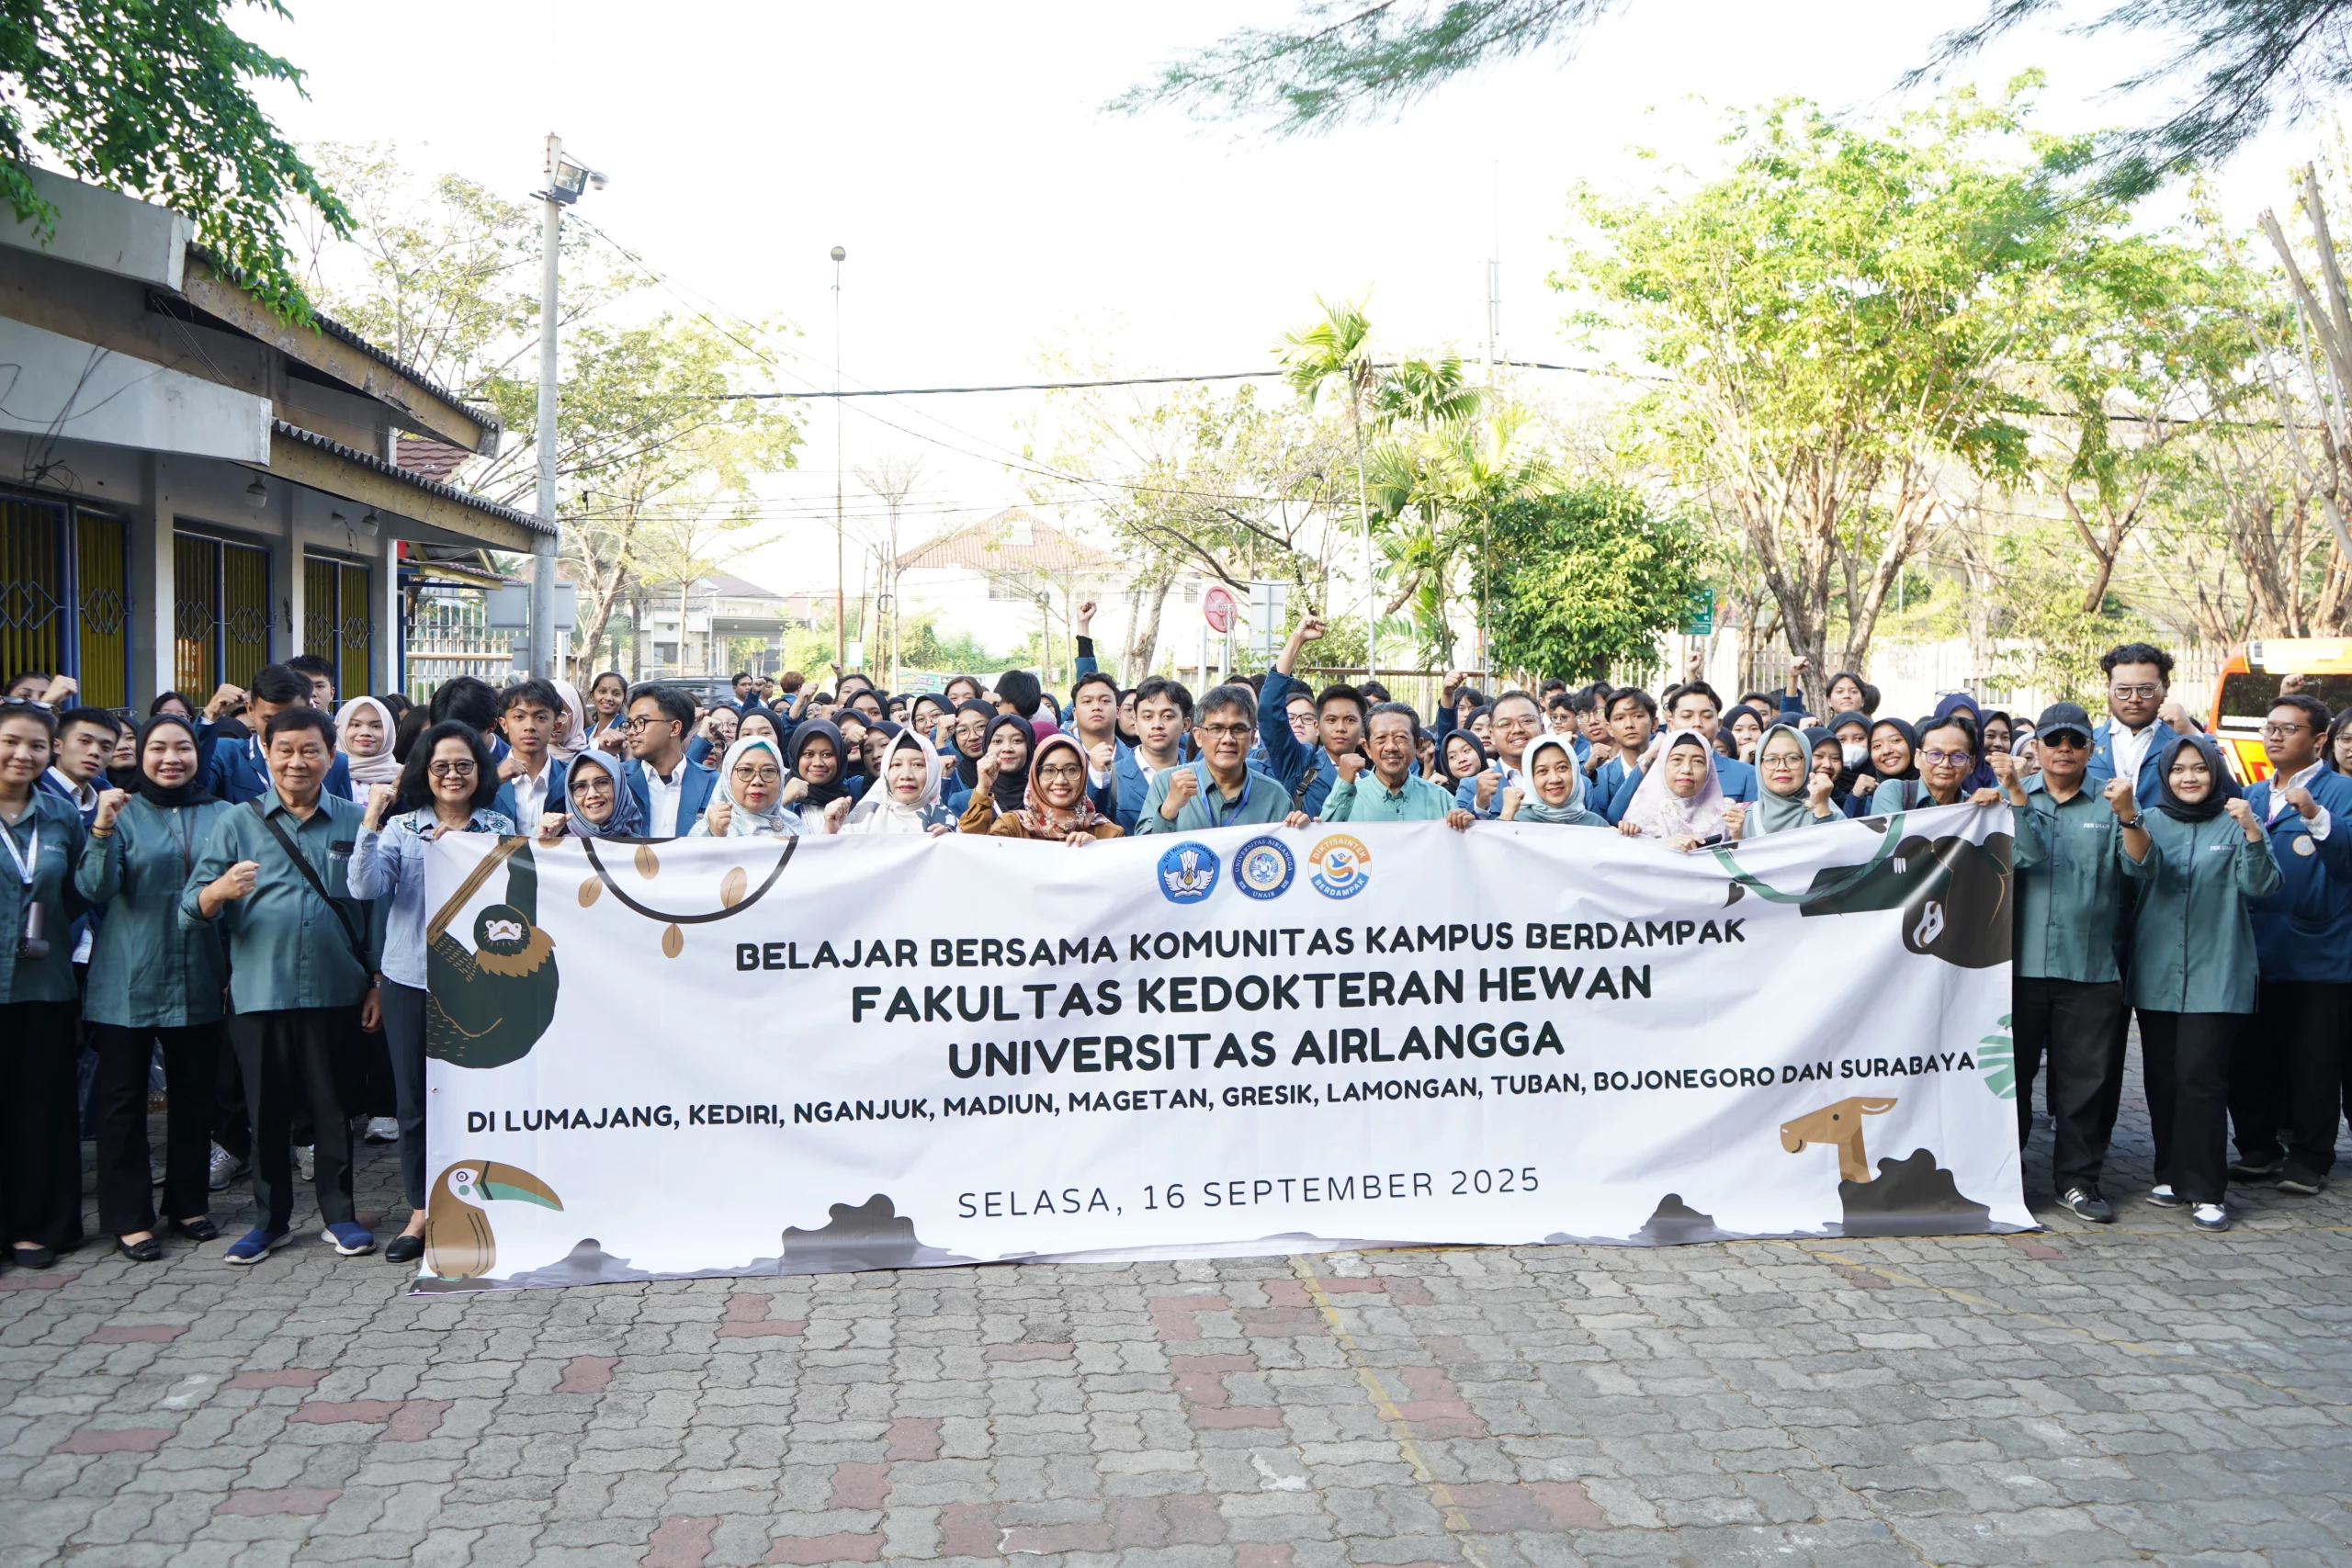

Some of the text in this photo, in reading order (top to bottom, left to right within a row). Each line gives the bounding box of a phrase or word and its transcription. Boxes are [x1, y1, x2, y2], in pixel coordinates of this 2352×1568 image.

[1163, 843, 1216, 863] TUT WURI HANDAYANI
[1235, 840, 1294, 872] UNIVERSITAS AIRLANGGA
[1313, 838, 1366, 859] DIKTISAINTEK
[1315, 878, 1365, 897] BERDAMPAK
[736, 917, 1747, 972] BELAJAR BERSAMA KOMUNITAS KAMPUS BERDAMPAK
[852, 964, 1652, 1023] FAKULTAS KEDOKTERAN HEWAN
[948, 1021, 1566, 1079] UNIVERSITAS AIRLANGGA
[468, 1051, 1975, 1134] DI LUMAJANG, KEDIRI, NGANJUK, MADIUN, MAGETAN, GRESIK, LAMONGAN, TUBAN, BOJONEGORO DAN SURABAYA
[958, 1167, 1539, 1219] SELASA, 16 SEPTEMBER 2025
